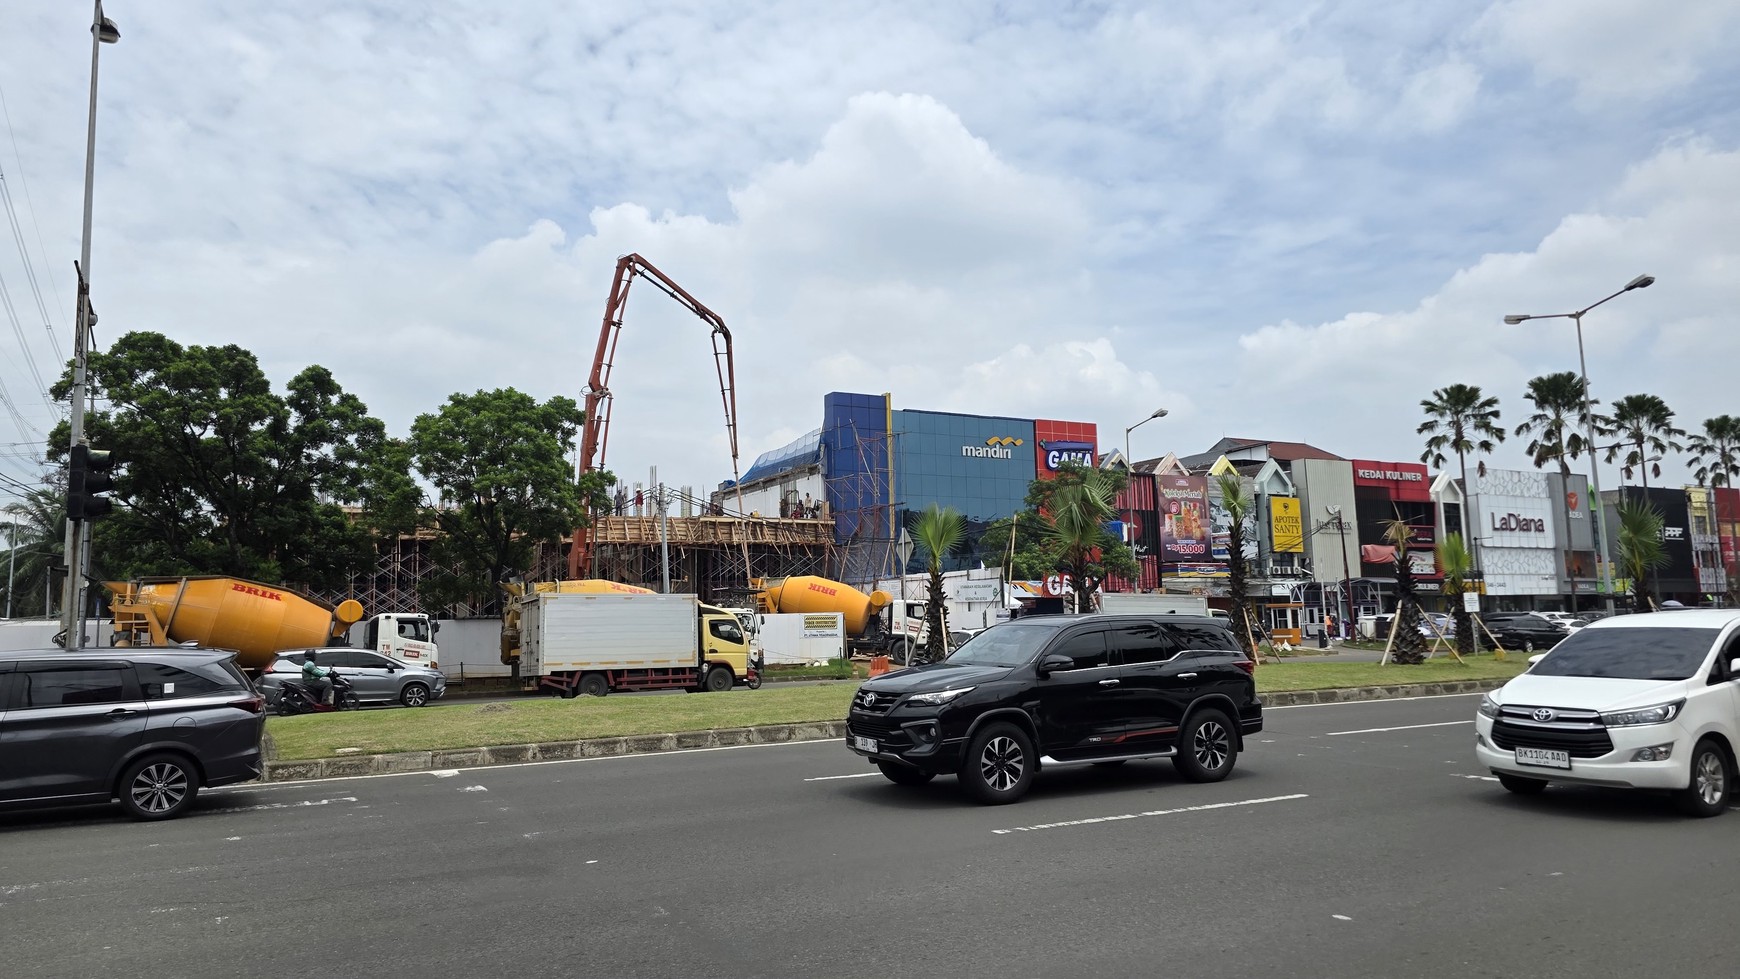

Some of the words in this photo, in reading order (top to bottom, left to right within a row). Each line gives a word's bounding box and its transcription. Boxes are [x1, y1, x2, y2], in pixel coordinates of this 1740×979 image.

[962, 443, 1012, 459] mandiri
[1048, 450, 1093, 468] GAMA
[1358, 469, 1385, 480] KEDAI
[1386, 471, 1422, 482] KULINER
[1274, 516, 1300, 525] APOTEK
[1491, 512, 1545, 533] LaDiana
[1274, 525, 1300, 534] SANTY
[232, 583, 282, 601] BRIK
[808, 583, 838, 597] BRIK
